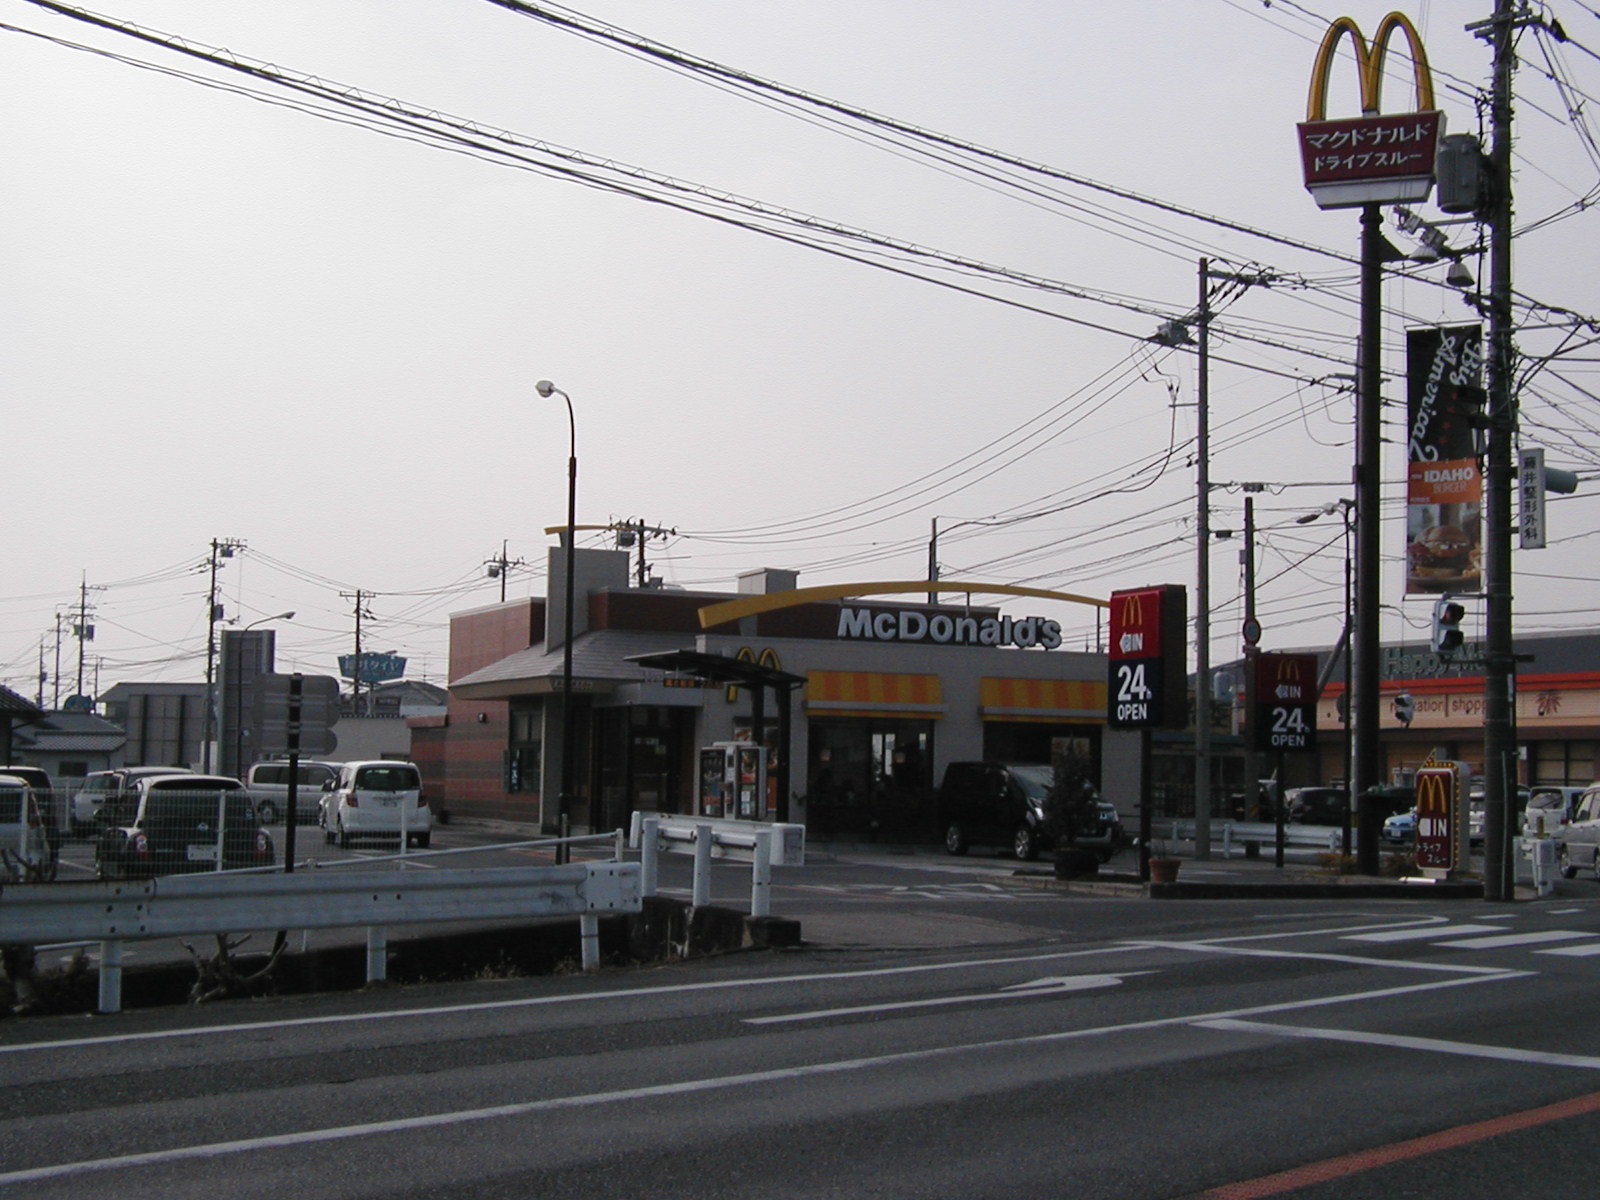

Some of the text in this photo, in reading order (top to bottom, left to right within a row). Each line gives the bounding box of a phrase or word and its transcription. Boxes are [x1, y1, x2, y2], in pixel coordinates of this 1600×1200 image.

[1305, 121, 1431, 149] マクドナルド
[1314, 151, 1422, 172] ドライブスルー
[1424, 467, 1475, 483] IDAHO
[837, 607, 1062, 650] McDonald's
[1131, 632, 1144, 653] IN
[1289, 684, 1302, 700] IN
[1117, 703, 1148, 722] OPEN
[1271, 734, 1305, 748] OPEN
[1432, 817, 1448, 838] IN
